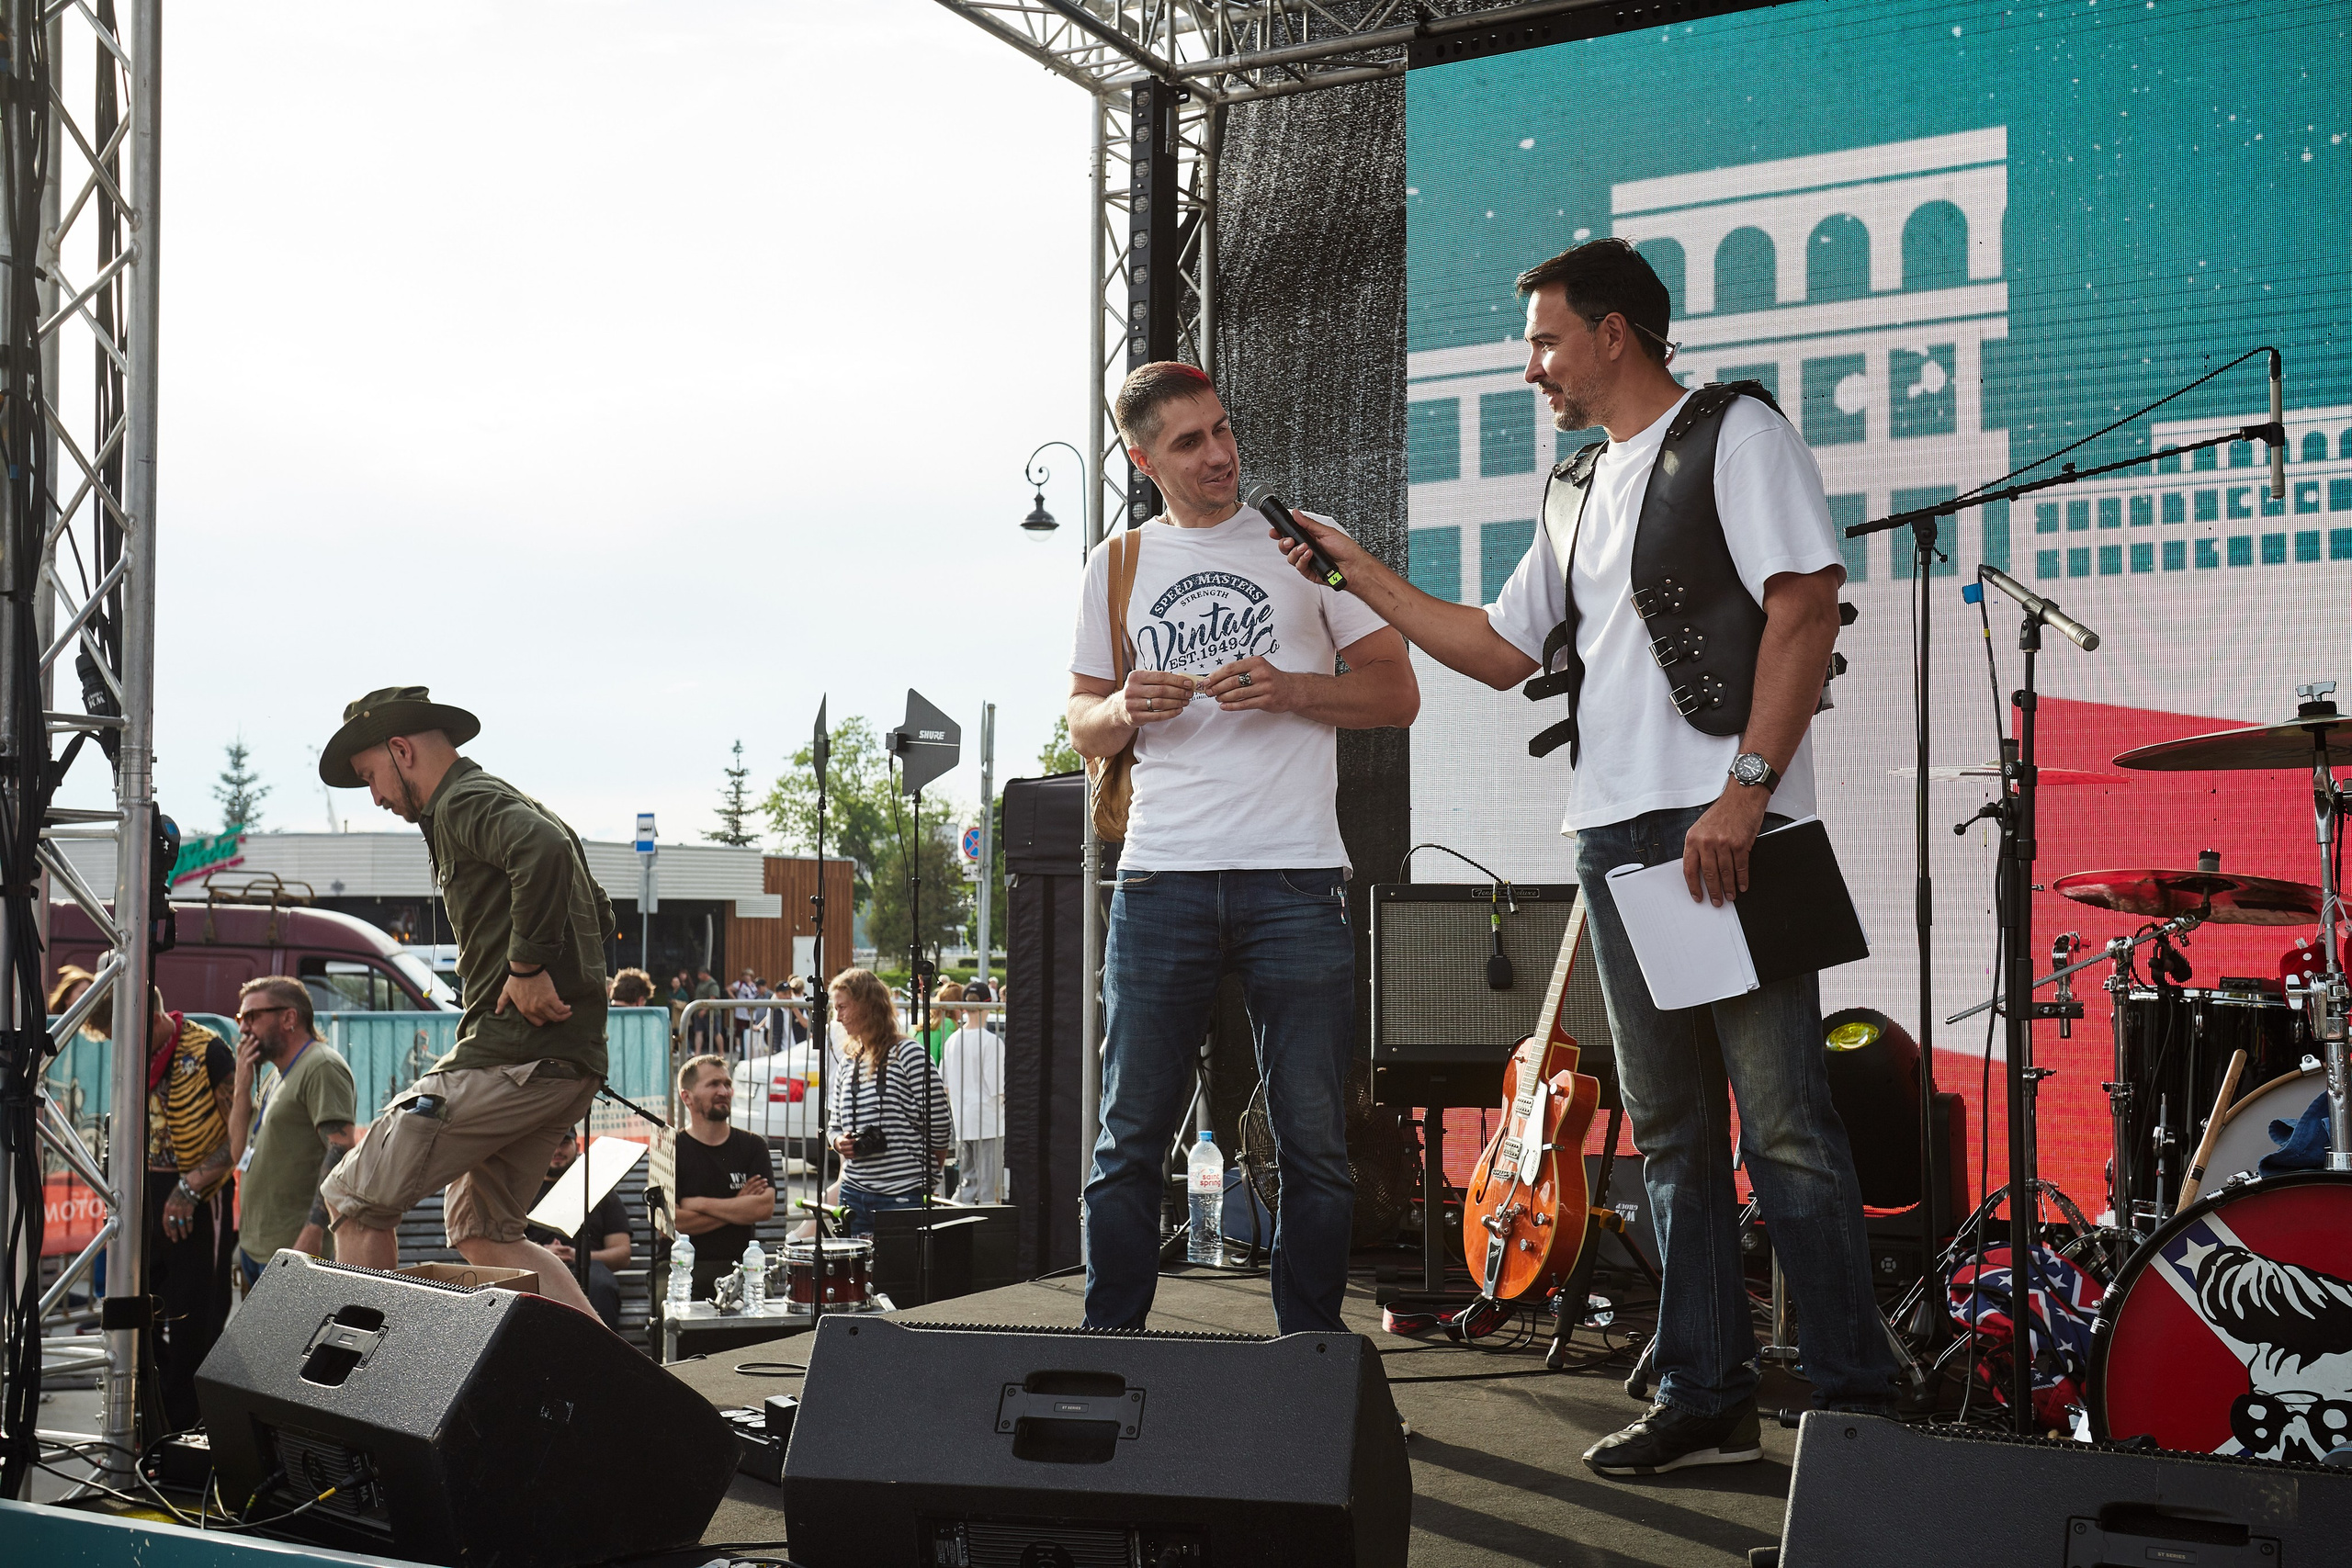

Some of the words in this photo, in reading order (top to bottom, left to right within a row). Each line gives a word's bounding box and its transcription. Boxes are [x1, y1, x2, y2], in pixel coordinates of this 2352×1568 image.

[1154, 580, 1193, 615] SPEED
[1198, 574, 1263, 602] MASTERS
[1180, 589, 1229, 607] STRENGTH
[1137, 602, 1275, 671] Vintage
[919, 730, 945, 740] SHURE
